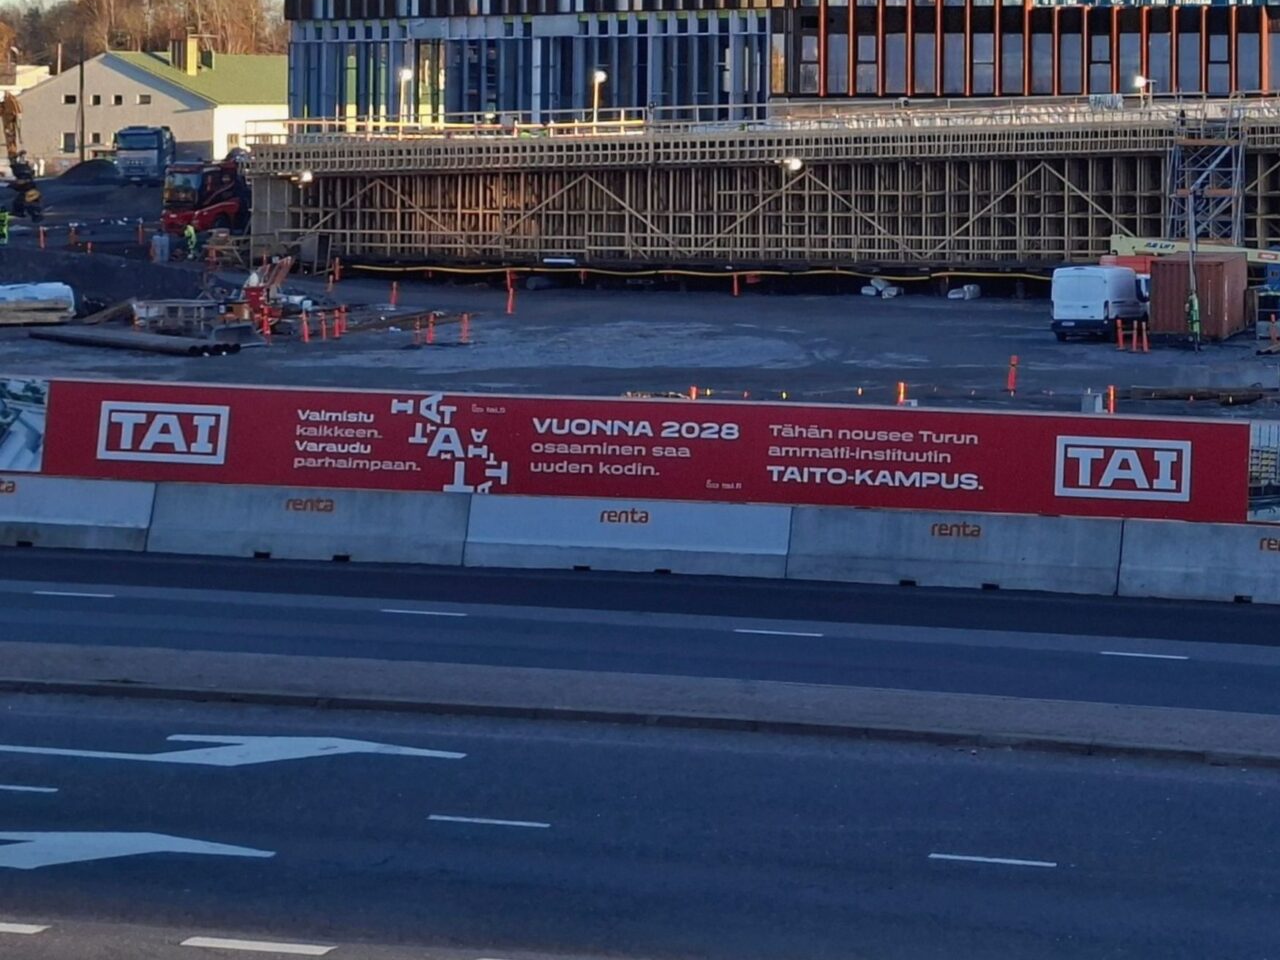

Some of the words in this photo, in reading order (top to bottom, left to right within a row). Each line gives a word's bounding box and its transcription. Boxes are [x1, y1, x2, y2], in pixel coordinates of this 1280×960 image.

[297, 409, 375, 423] Valmistu
[111, 412, 216, 453] TAI
[296, 424, 383, 439] kaikkeen.
[532, 417, 653, 437] VUONNA
[660, 421, 740, 440] 2028
[769, 423, 833, 439] Tähän
[838, 428, 914, 442] nousee
[919, 430, 978, 444] Turun
[295, 440, 372, 454] Varaudu
[531, 442, 646, 456] osaaminen
[652, 446, 691, 457] saa
[768, 445, 951, 463] ammatti-instituutin
[293, 456, 421, 471] parhaimpaan.
[530, 460, 593, 474] uuden
[599, 462, 660, 476] kodin.
[1067, 447, 1177, 490] TAI
[766, 465, 984, 490] TAITO-KAMPUS.
[286, 498, 334, 512] renta
[600, 508, 649, 523] renta
[931, 521, 981, 537] renta
